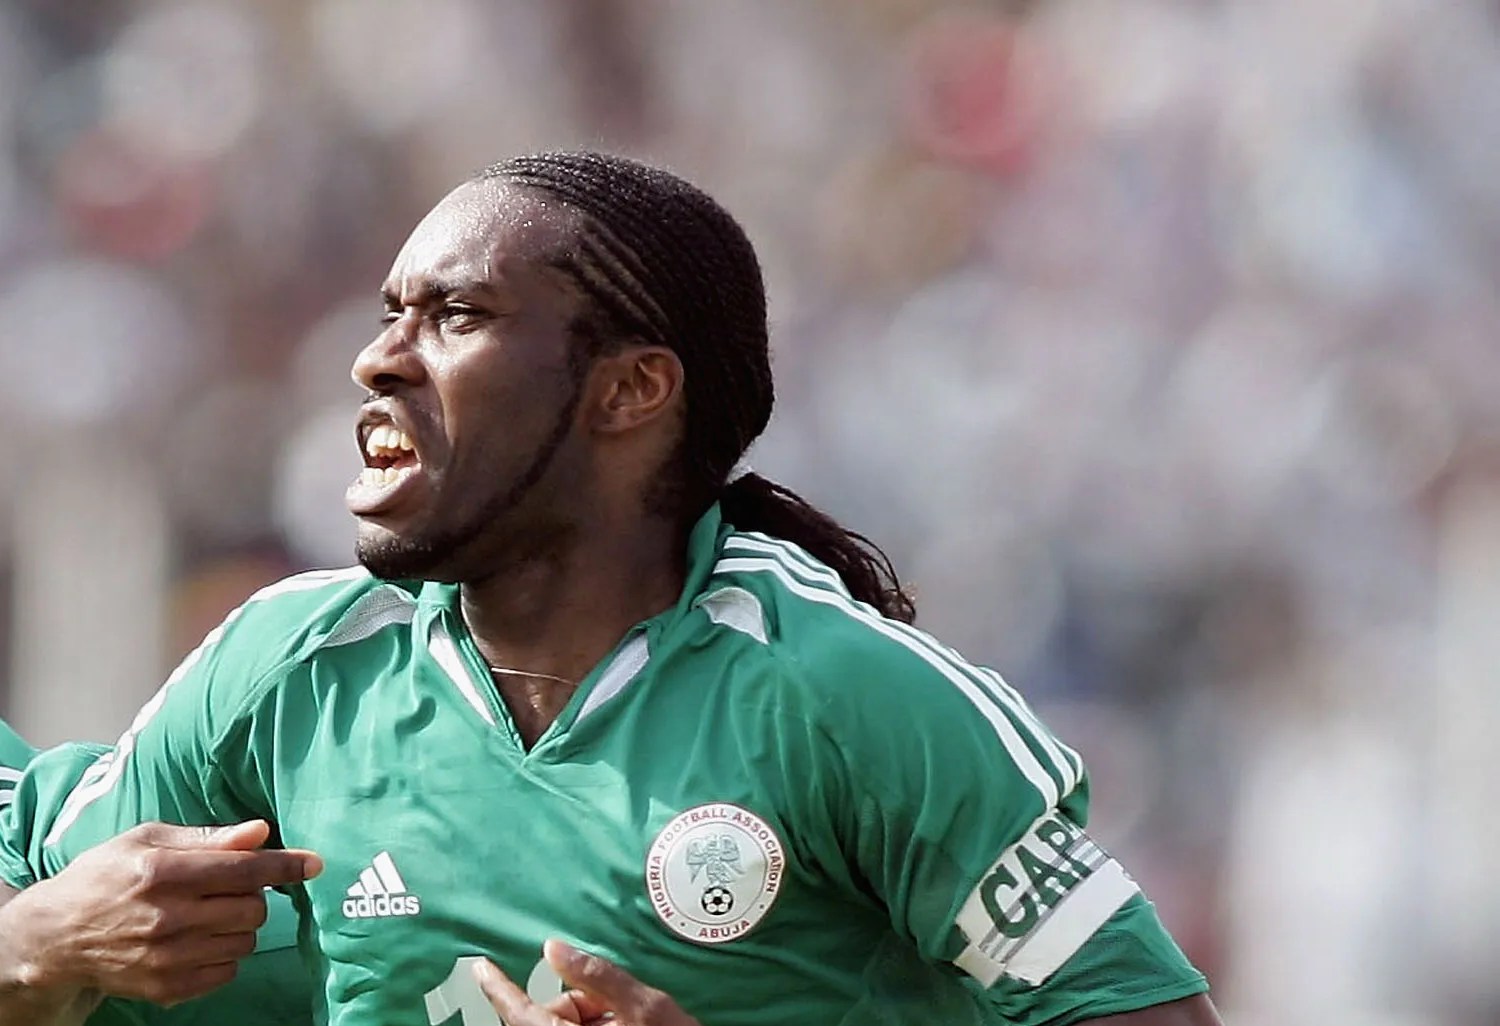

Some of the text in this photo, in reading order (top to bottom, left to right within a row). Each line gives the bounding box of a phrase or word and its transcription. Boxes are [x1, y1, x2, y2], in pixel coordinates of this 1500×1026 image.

[650, 807, 783, 918] NIGERIA FOOTBALL ASSOCIATION
[980, 814, 1093, 939] CAP
[342, 892, 421, 919] adidas
[698, 920, 750, 939] ABUJA
